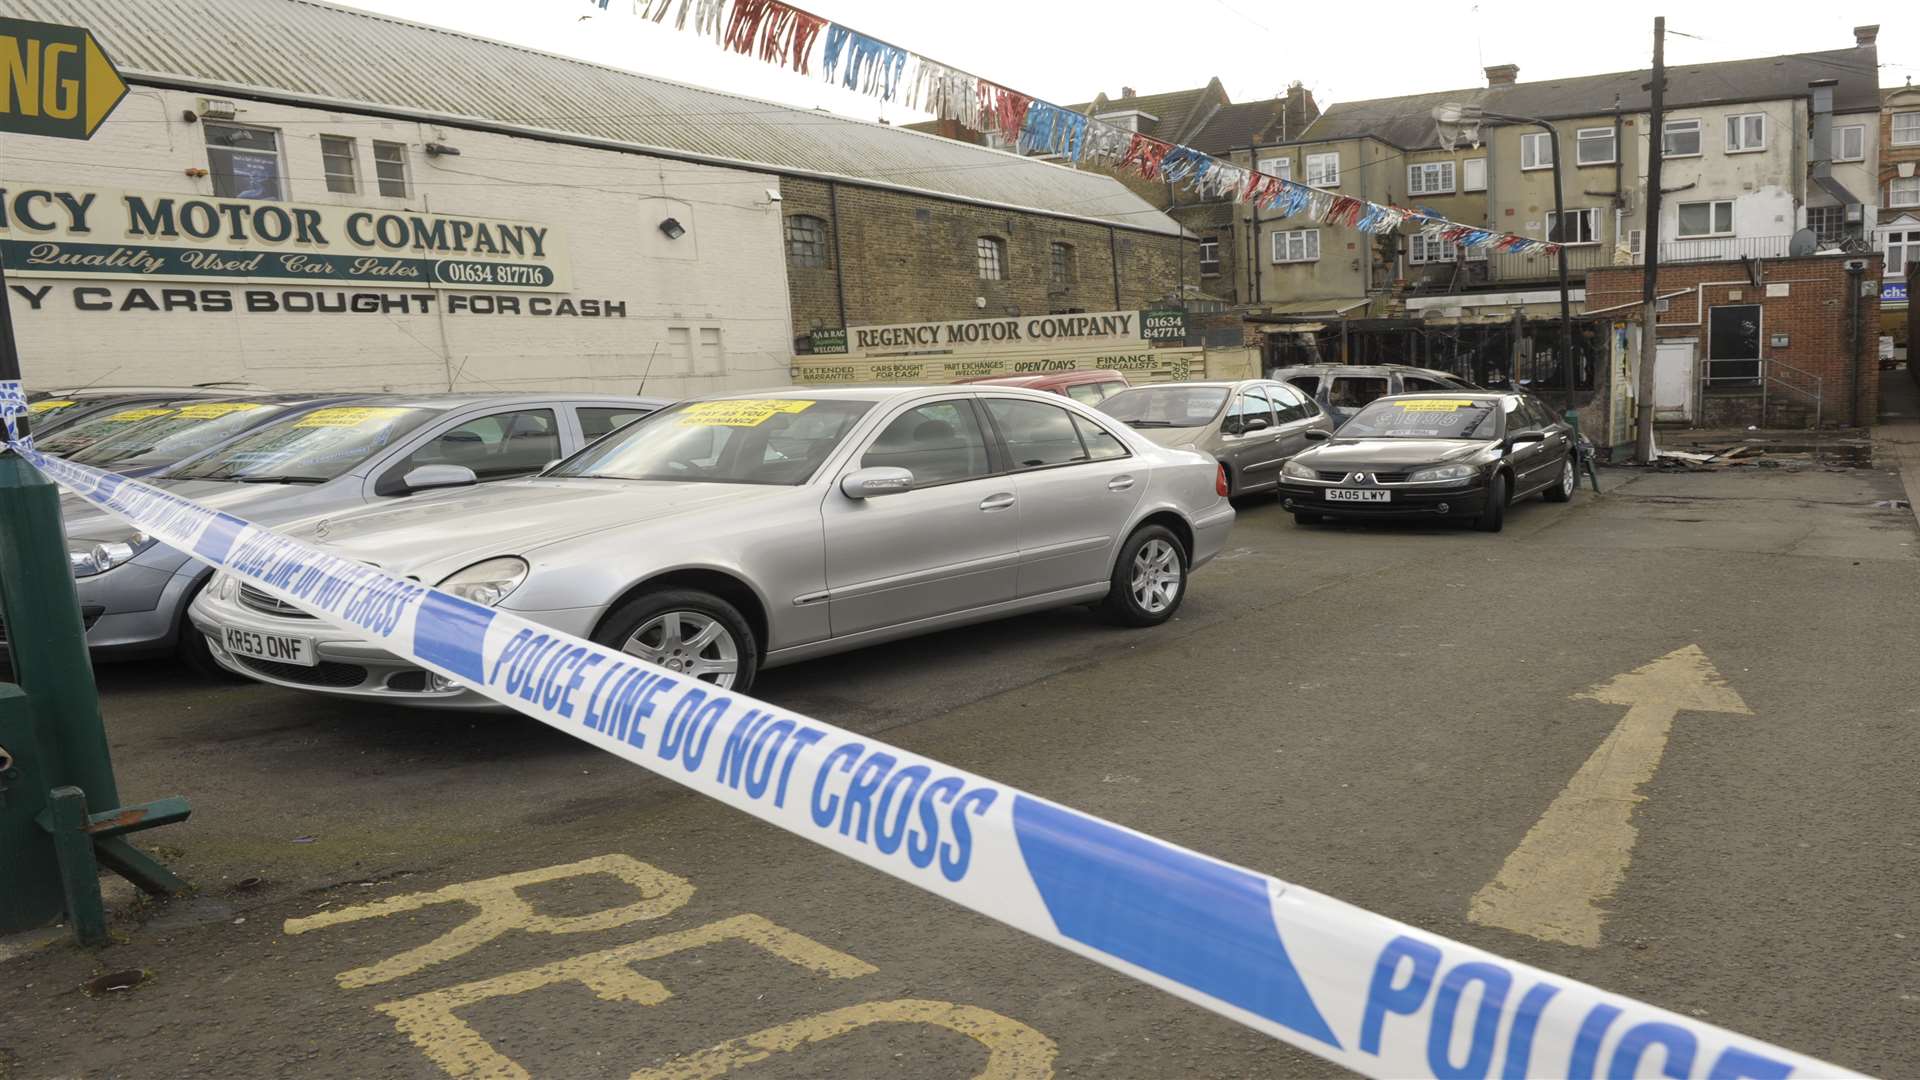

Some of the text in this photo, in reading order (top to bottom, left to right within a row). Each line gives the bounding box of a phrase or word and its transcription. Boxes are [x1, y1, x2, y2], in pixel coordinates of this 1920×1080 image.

[124, 195, 329, 244] MOTOR
[347, 213, 547, 257] COMPANY
[27, 243, 420, 278] Quality Used Car Sales
[449, 263, 544, 285] 01634 817716
[73, 287, 233, 312] CARS
[246, 290, 435, 315] BOUGHT
[449, 294, 521, 315] FOR
[529, 297, 626, 317] CASH
[856, 314, 1132, 348] REGENCY MOTOR COMPANY
[1143, 327, 1186, 338] 847714
[1146, 317, 1182, 327] 01634
[813, 345, 847, 353] WELCOME
[1096, 354, 1155, 365] FINANCE
[803, 366, 855, 374] EXTENDED
[870, 363, 923, 372] CARS BOUGHT
[944, 361, 1004, 371] PART EXCHANGES
[1096, 362, 1158, 370] SPECIALISTS
[1330, 490, 1385, 500] SA05 LWY
[264, 543, 317, 590] LINE
[290, 552, 338, 599] DO
[312, 560, 363, 612] NOT
[343, 570, 424, 637] CROSS
[226, 628, 302, 661] KR53 ONF
[489, 628, 999, 883] POLICE LINE DO NOT CROSS
